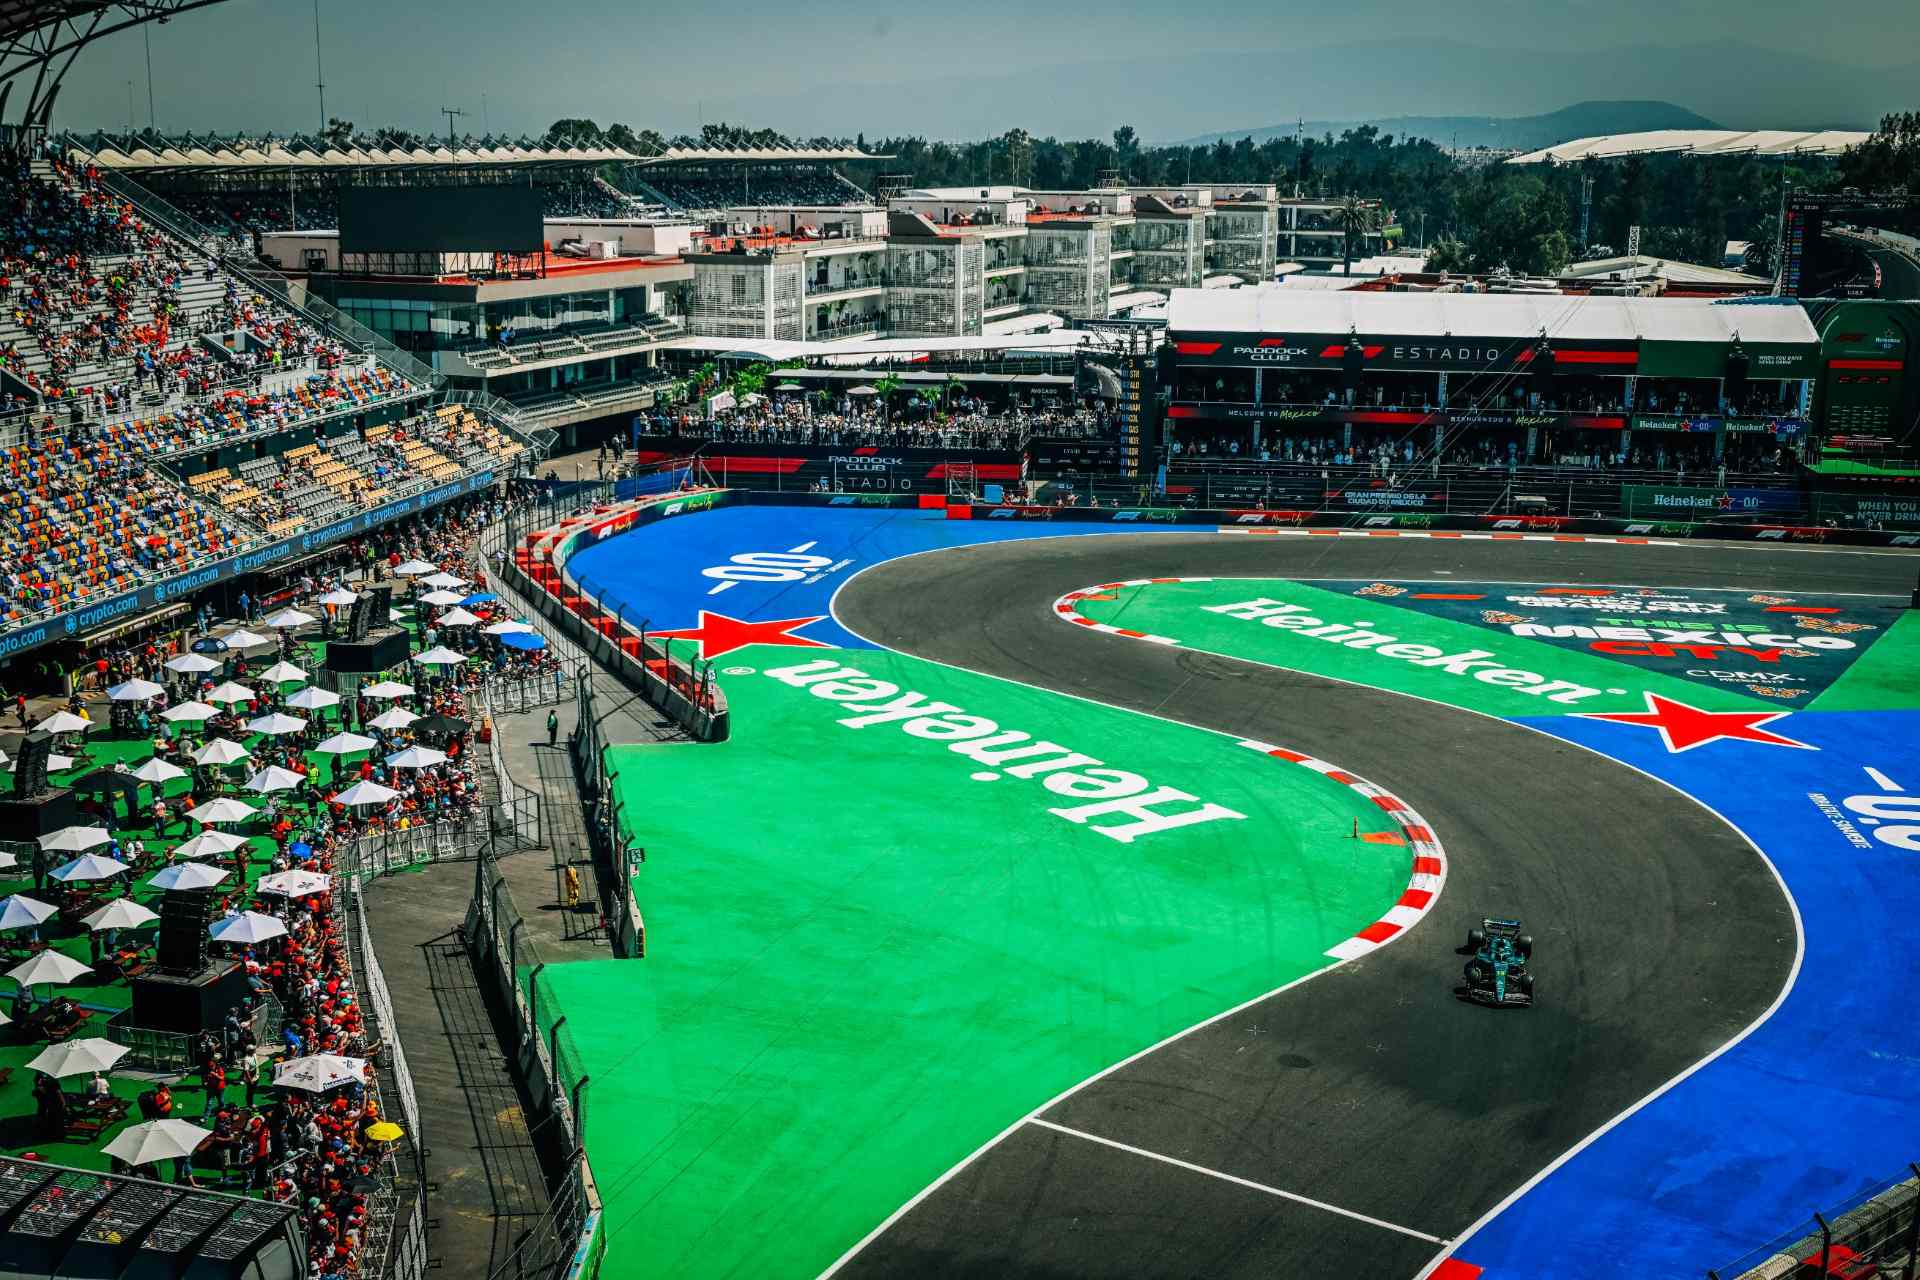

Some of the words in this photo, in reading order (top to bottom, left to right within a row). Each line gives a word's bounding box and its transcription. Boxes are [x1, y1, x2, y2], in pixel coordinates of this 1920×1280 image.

[1233, 347, 1308, 356] PADDOCK
[1251, 354, 1291, 362] CLUB
[1393, 348, 1499, 361] ESTADIO
[1639, 420, 1677, 429] Heineken
[1726, 422, 1765, 431] Heineken
[828, 455, 903, 465] PADDOCK
[846, 464, 886, 472] CLUB
[428, 484, 461, 503] crypto.com
[1653, 494, 1714, 506] Heineken
[373, 503, 410, 523] crypto.com
[1857, 501, 1891, 511] WHEN
[1894, 502, 1917, 512] YOU
[312, 522, 353, 549] crypto.com
[243, 543, 290, 569] crypto.com
[167, 567, 219, 597] crypto.com
[79, 597, 138, 627] crypto.com
[1595, 617, 1714, 630] THIS
[1720, 623, 1771, 633] IS
[1510, 623, 1856, 650] MEXICO
[1200, 597, 1601, 705] Heineken
[1590, 641, 1782, 664] CITY
[762, 659, 1249, 844] Heineken
